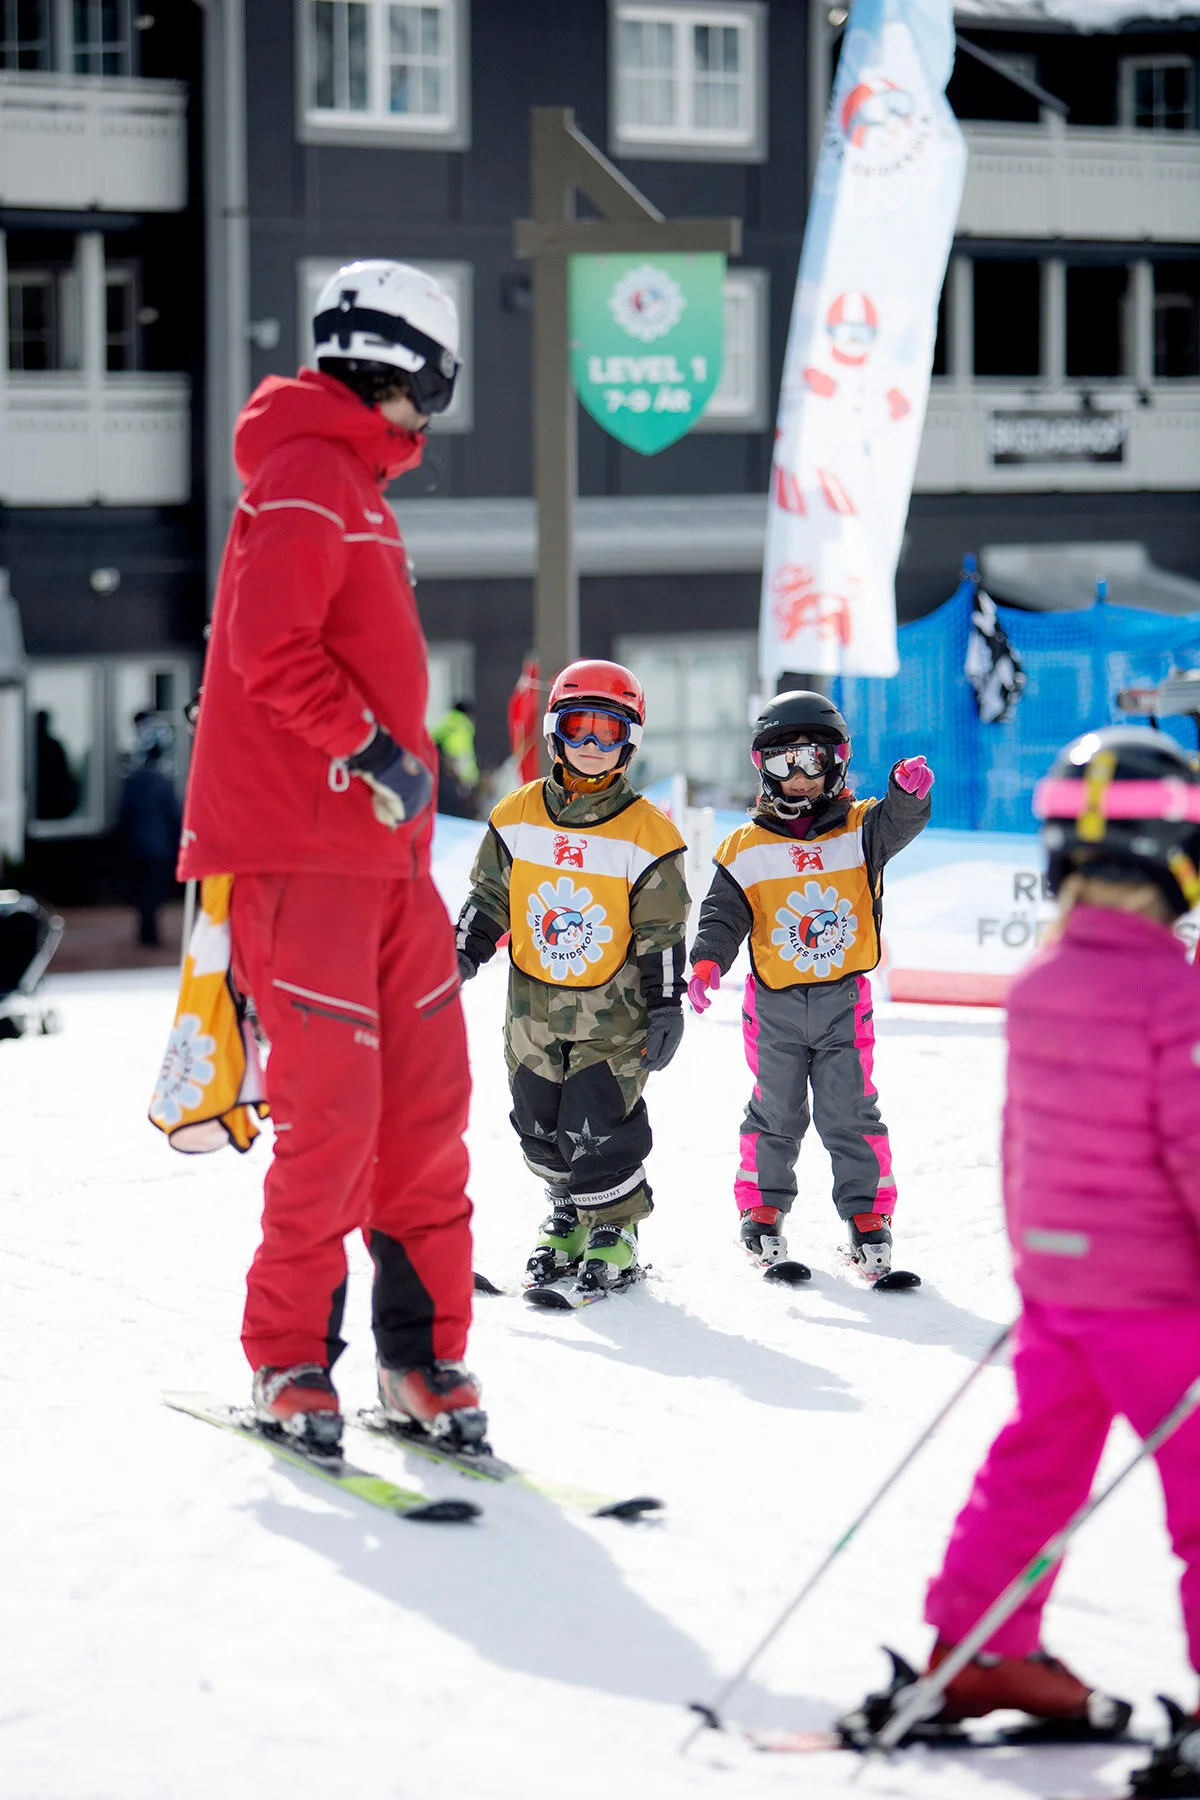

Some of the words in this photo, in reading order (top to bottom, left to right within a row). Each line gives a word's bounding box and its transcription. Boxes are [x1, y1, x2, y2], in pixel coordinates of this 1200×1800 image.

[588, 355, 685, 384] LEVEL
[689, 355, 708, 384] 1
[603, 387, 651, 414] 7-9
[652, 382, 692, 413] ÅR
[550, 921, 594, 961] SKIDSKOLA
[788, 925, 810, 958] VALLES
